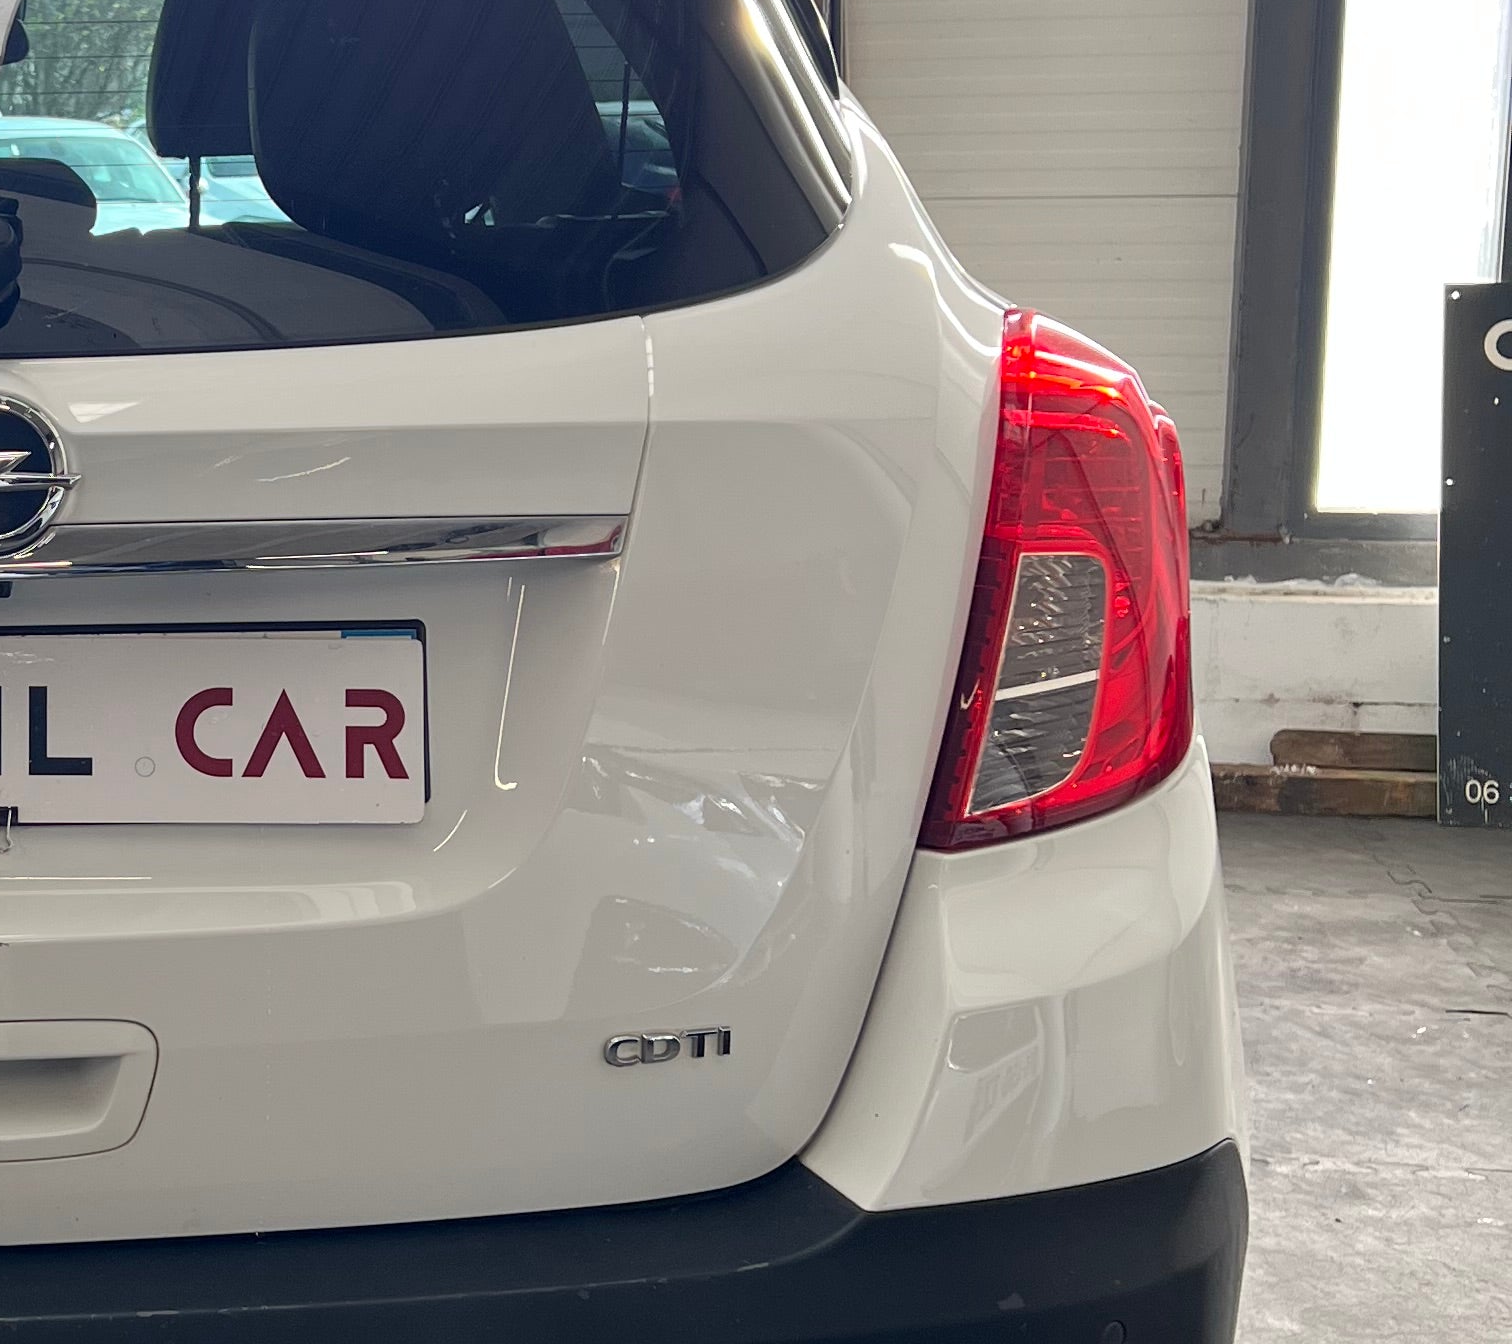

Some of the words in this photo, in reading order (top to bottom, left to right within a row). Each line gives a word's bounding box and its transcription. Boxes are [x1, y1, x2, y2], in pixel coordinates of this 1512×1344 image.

[174, 686, 410, 780] CAR
[1465, 779, 1500, 804] 06
[603, 1025, 732, 1068] CDTI
